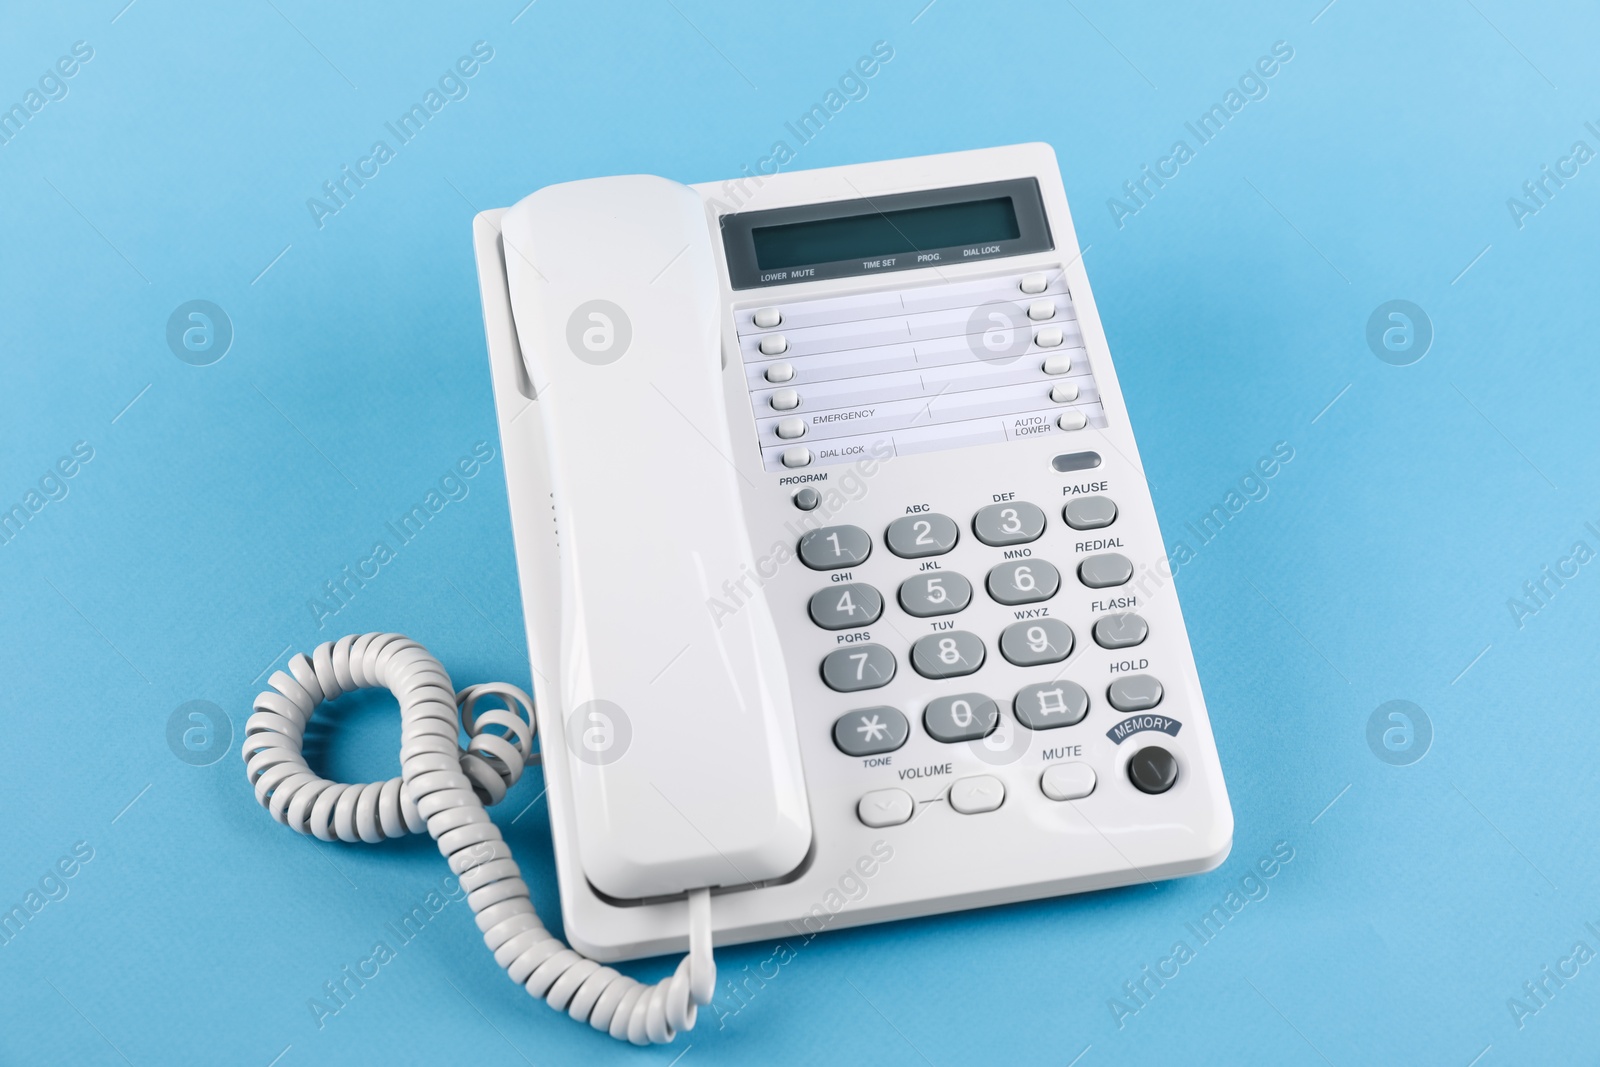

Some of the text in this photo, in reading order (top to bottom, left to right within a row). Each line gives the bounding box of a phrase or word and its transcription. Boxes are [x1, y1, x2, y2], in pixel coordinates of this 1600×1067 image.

[917, 253, 942, 262] PROG.
[963, 245, 1000, 257] DIAL LOCK
[863, 258, 896, 270] TIME SET
[761, 271, 787, 282] LOWER
[791, 268, 815, 278] MUTE
[812, 409, 876, 424] EMERGENCY
[1015, 416, 1047, 428] AUTO/
[1015, 425, 1051, 436] LOWER
[820, 446, 865, 458] DIAL LOCK
[779, 473, 828, 486] PROGRAM
[1062, 481, 1108, 496] PAUSE
[992, 492, 1016, 502] DEF
[905, 503, 930, 514] ABC
[1000, 508, 1021, 532] 3
[913, 520, 934, 546] 2
[826, 532, 842, 557] 1
[1075, 537, 1124, 553] REDIAL
[1004, 548, 1032, 560] MNO
[919, 561, 941, 572] JKL
[831, 572, 853, 583] GHI
[1014, 566, 1035, 591] 6
[926, 578, 947, 604] 5
[836, 590, 856, 616] 4
[1091, 596, 1137, 612] FLASH
[1014, 607, 1050, 620] WXYZ
[930, 620, 955, 632] TUV
[836, 631, 871, 644] PQRS
[1026, 626, 1048, 653] 9
[938, 638, 960, 665] 8
[849, 653, 869, 680] 7
[1109, 658, 1149, 673] HOLD
[950, 700, 972, 728] 0
[1113, 717, 1173, 740] MEMORY
[1042, 744, 1082, 761] MUTE
[862, 757, 892, 768] TONE
[898, 763, 953, 780] VOLUME
